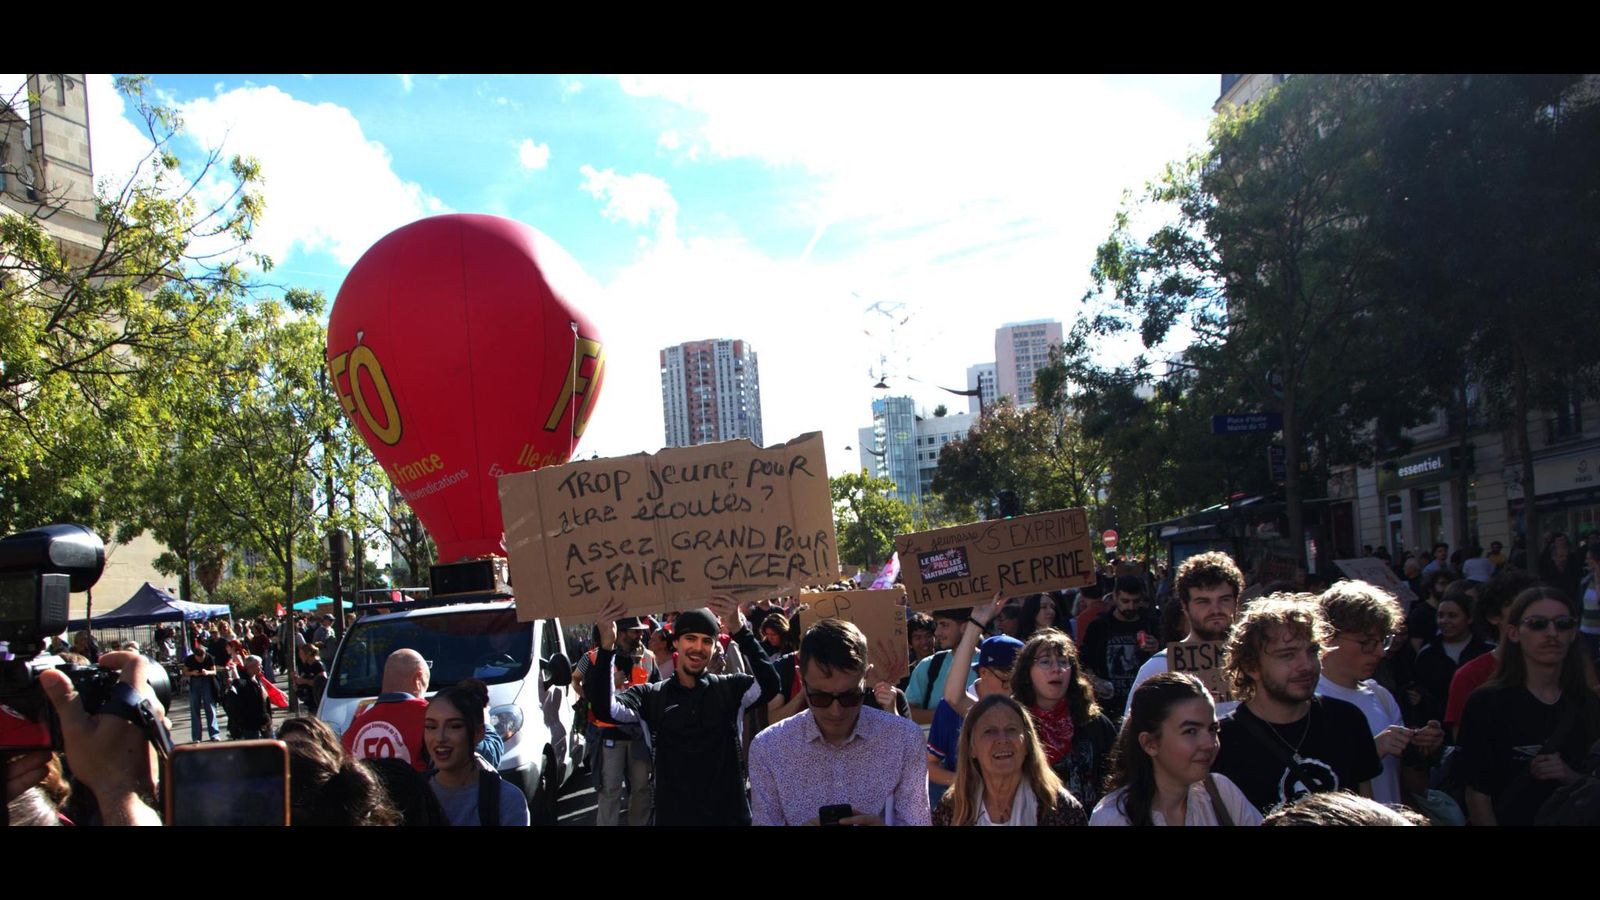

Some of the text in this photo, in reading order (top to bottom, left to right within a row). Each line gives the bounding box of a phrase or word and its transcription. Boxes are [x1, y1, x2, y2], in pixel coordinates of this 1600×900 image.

[672, 525, 766, 550] GRAND
[987, 515, 1085, 550] S'EXPRIME
[920, 557, 930, 565] LE
[933, 558, 962, 569] PAS LES
[567, 571, 600, 597] SE
[913, 549, 1091, 605] LA POLICE REPRIME
